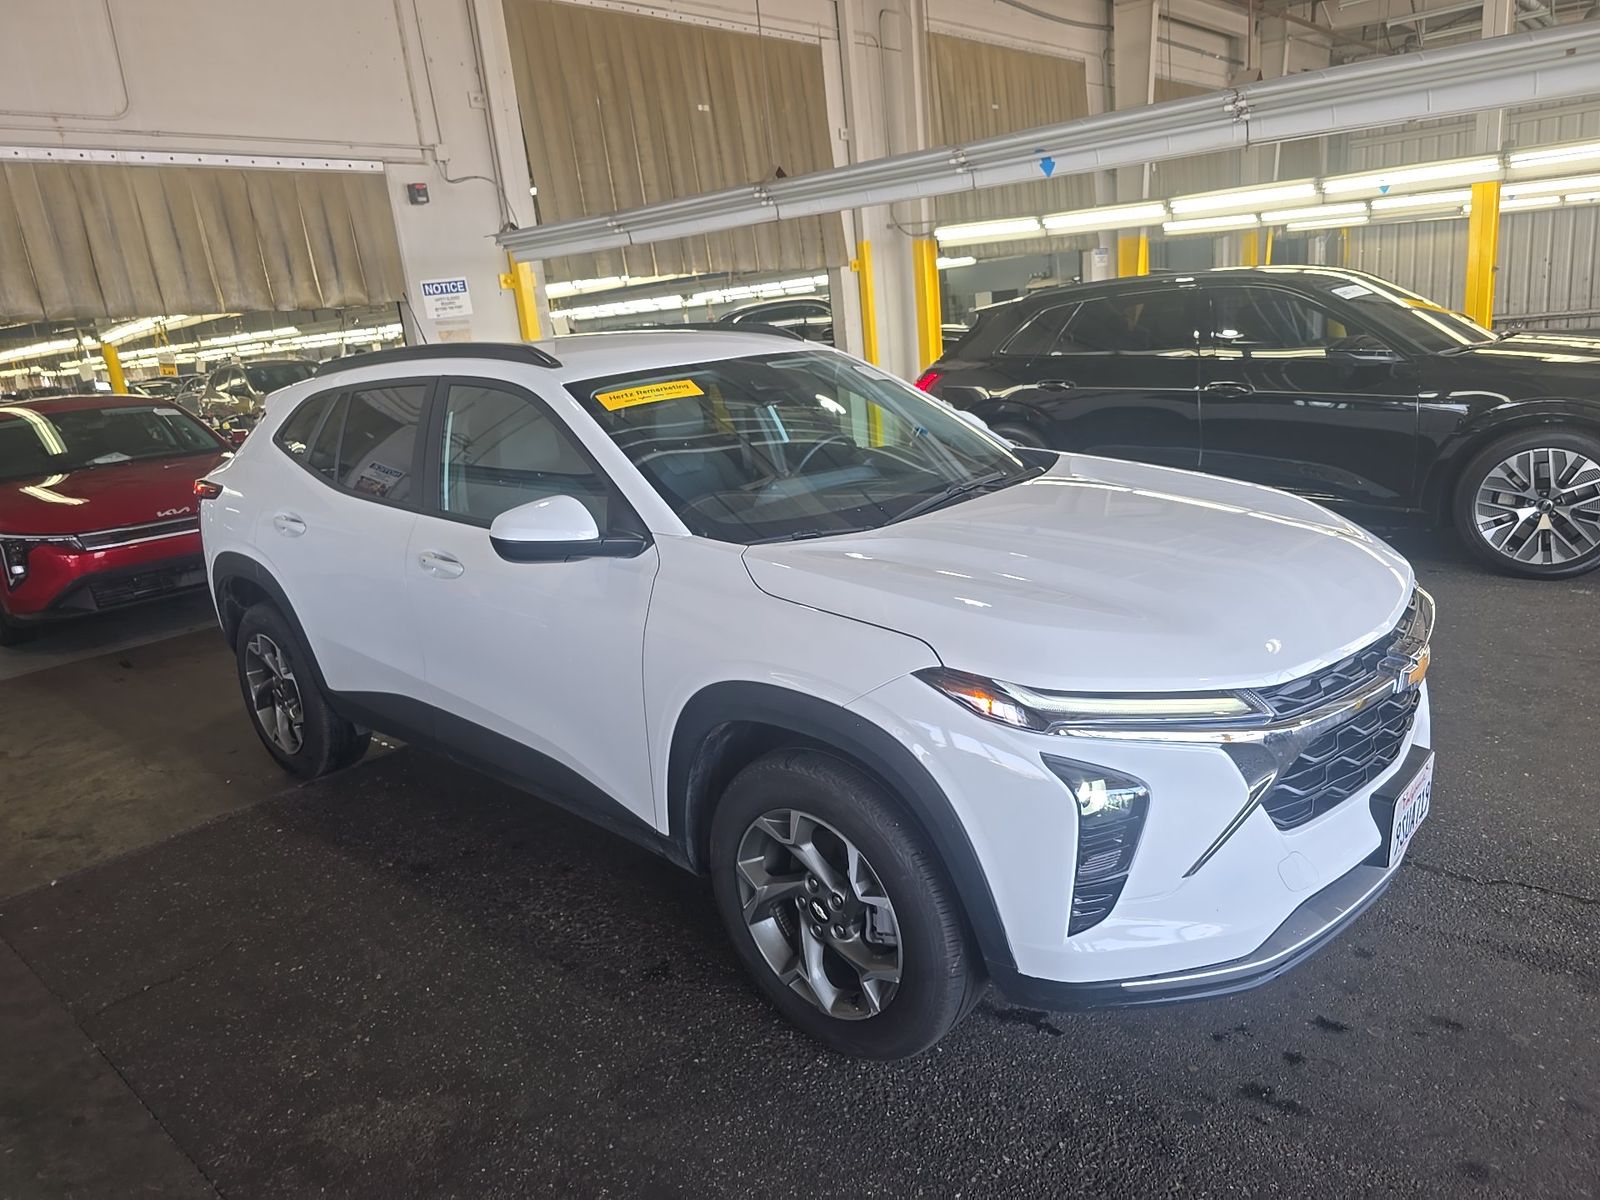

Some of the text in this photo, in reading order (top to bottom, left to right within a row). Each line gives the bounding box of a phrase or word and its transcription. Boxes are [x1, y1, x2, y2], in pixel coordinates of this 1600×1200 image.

[424, 281, 465, 295] NOTICE
[608, 392, 635, 401] Hertz
[635, 383, 690, 396] Remarketing
